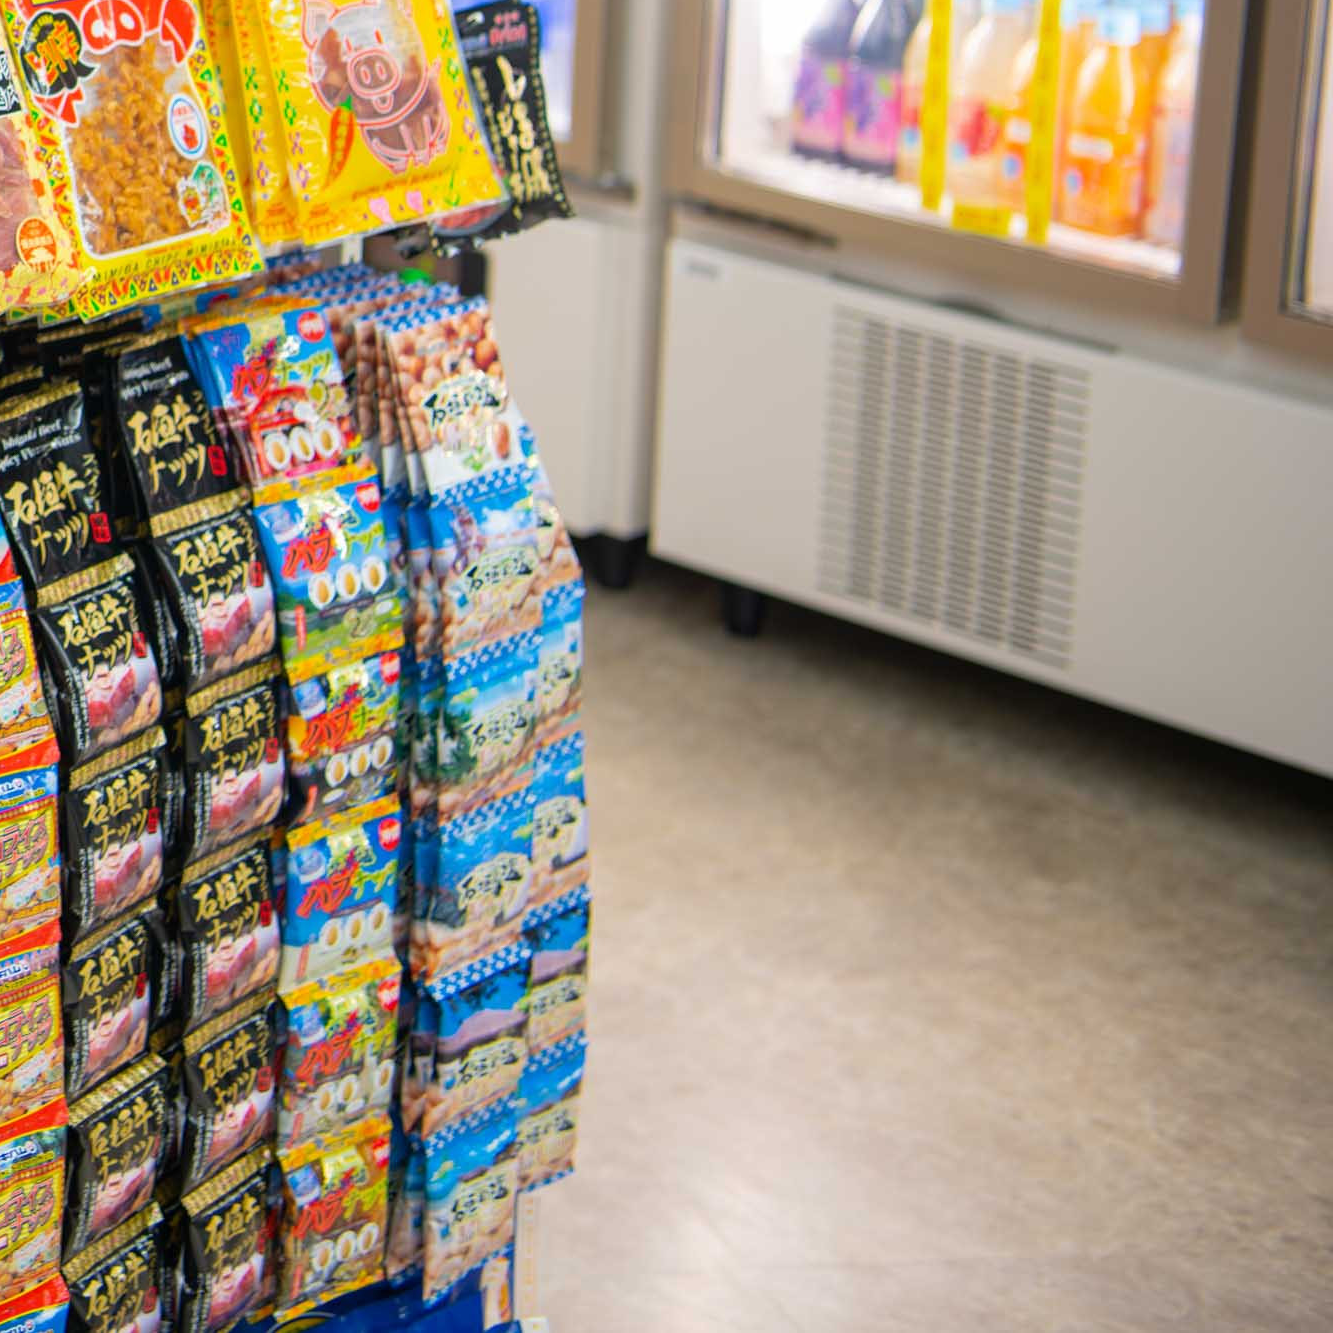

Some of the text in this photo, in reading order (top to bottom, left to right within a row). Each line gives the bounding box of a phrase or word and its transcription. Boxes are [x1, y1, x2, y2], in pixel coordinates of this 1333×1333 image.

[127, 394, 200, 457] 石垣牛
[4, 461, 86, 529] 石垣牛
[148, 442, 207, 495] ナッツ
[31, 511, 90, 566] ナッツ
[171, 523, 245, 578] 石垣牛
[192, 560, 252, 609] ナッツ
[58, 594, 129, 650] 石垣牛
[76, 630, 134, 678] ナッツ
